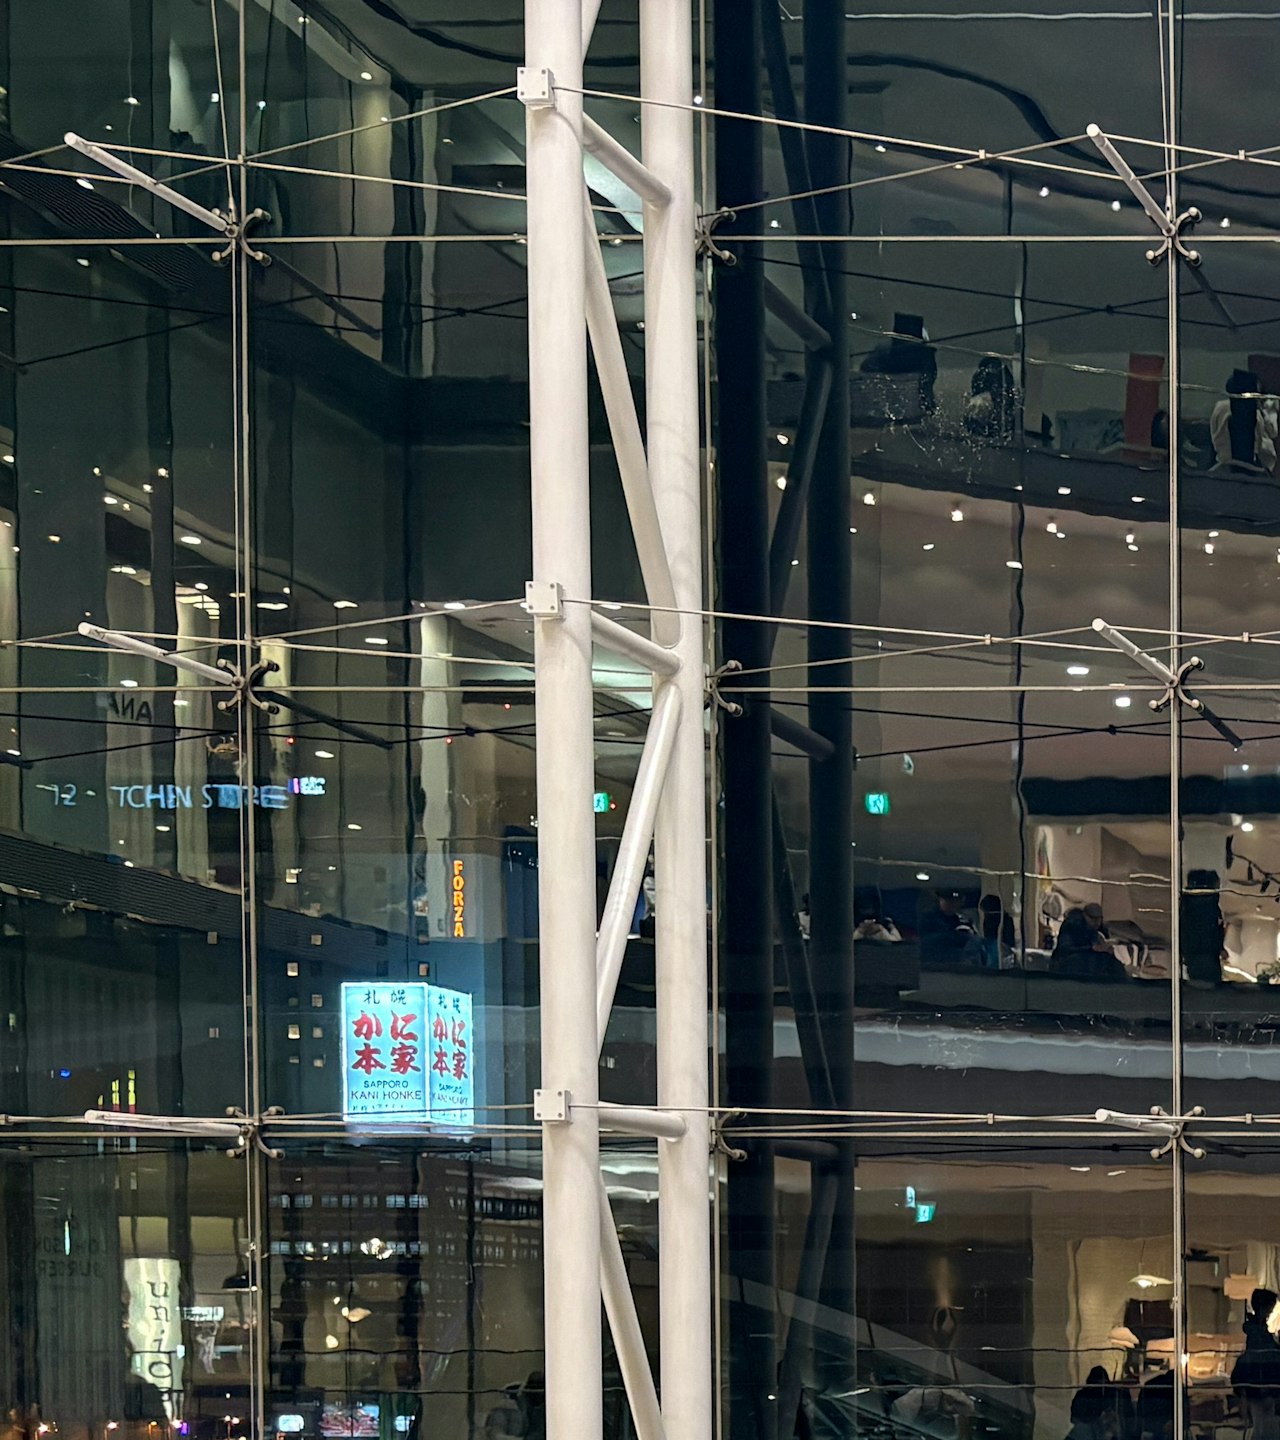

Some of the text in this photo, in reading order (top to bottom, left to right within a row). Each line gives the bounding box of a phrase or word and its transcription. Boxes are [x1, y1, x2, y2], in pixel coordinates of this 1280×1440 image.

[453, 859, 465, 938] FORZA
[364, 988, 407, 1005] 札幌
[352, 1010, 419, 1042] かに
[432, 1012, 466, 1049] かに
[351, 1042, 421, 1076] 本家
[432, 1045, 469, 1081] 本家
[351, 1090, 422, 1100] KANI HONKE
[363, 1080, 409, 1089] SAPPORO
